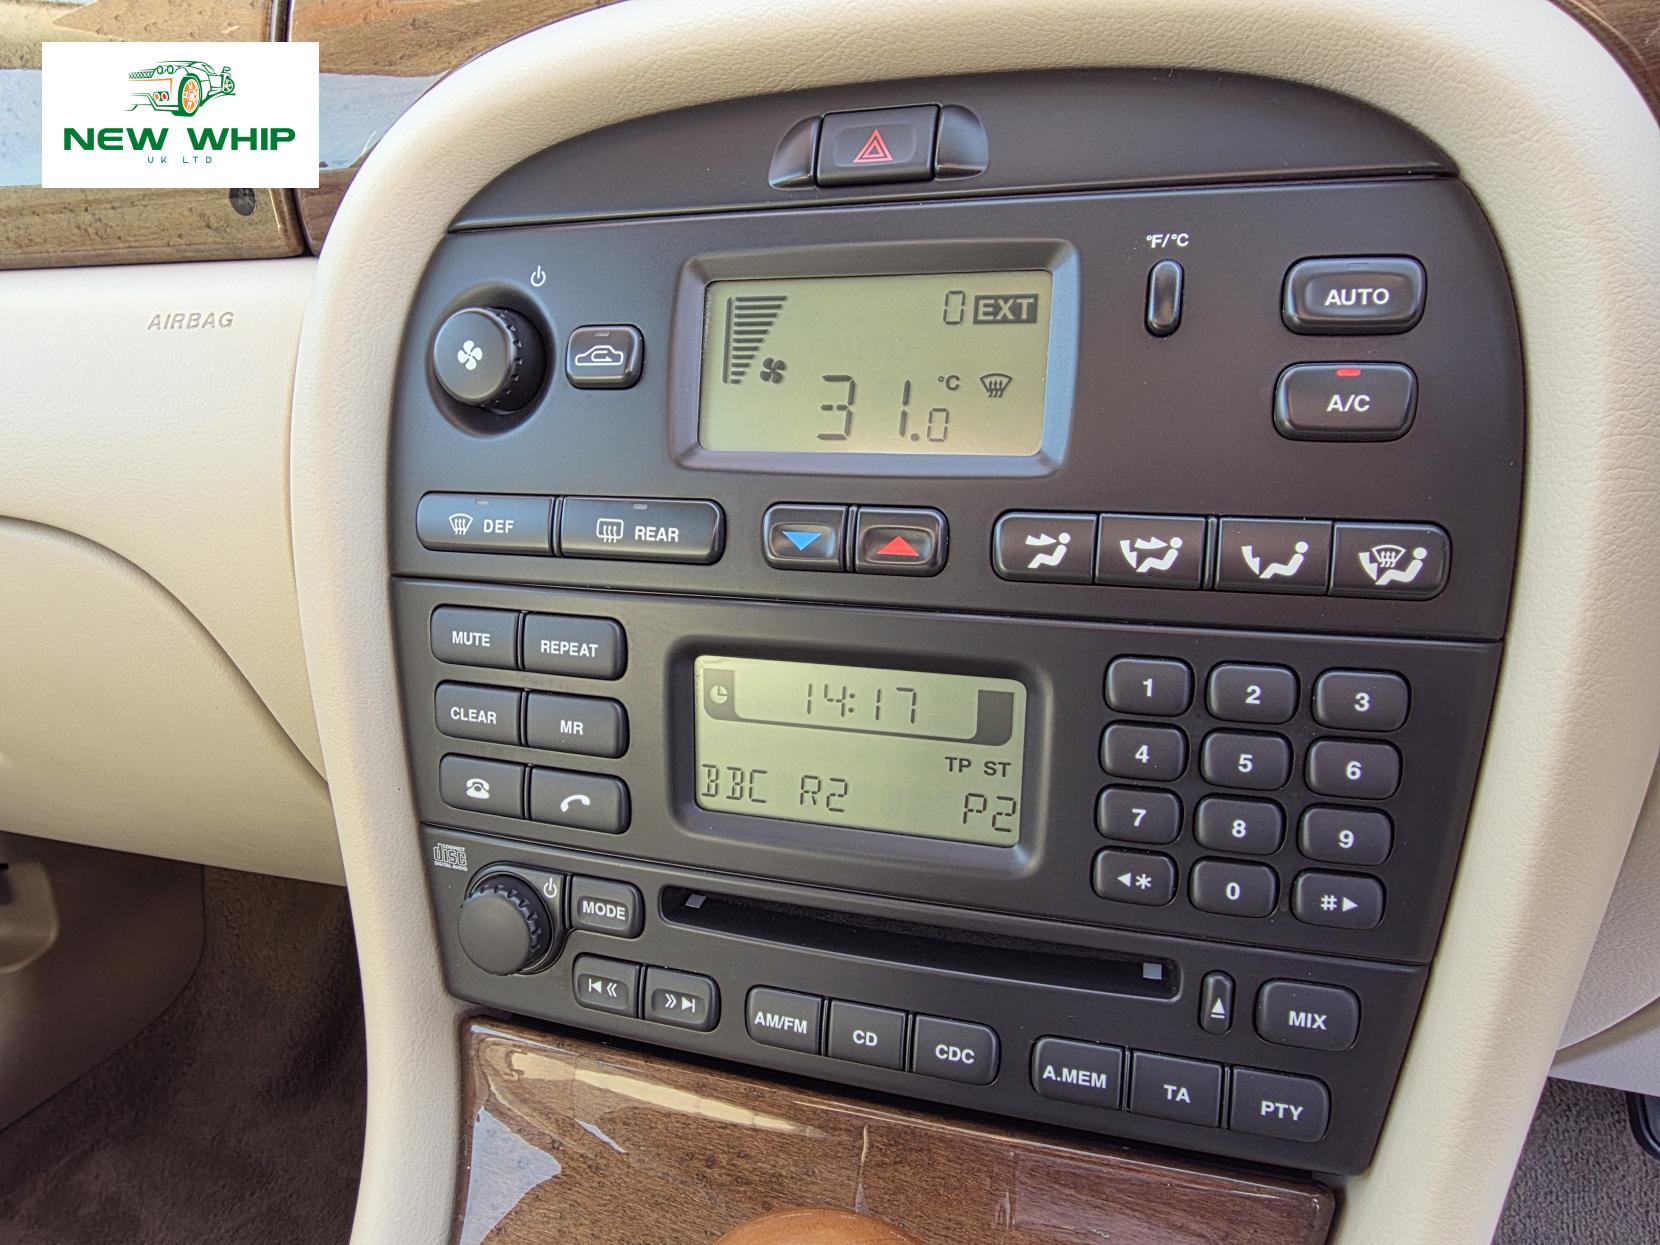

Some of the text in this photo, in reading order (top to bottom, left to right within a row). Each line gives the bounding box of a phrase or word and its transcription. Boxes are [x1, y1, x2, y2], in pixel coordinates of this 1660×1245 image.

[1324, 287, 1390, 306] AUTO
[977, 297, 1035, 320] EXT
[147, 311, 235, 330] AIRBAG
[1326, 394, 1371, 412] A/C
[483, 519, 514, 533] DEF
[634, 526, 679, 542] REAR
[452, 630, 490, 647] MUTE
[540, 639, 598, 658] REPEAT
[1142, 678, 1153, 697] 1
[1245, 685, 1261, 705] 2
[804, 682, 917, 725] 14:17
[1354, 692, 1370, 712] 3
[450, 706, 497, 725] CLEAR
[560, 719, 584, 736] MR
[1135, 744, 1150, 764] 4
[1238, 754, 1253, 773] 5
[945, 756, 1011, 778] TP ST
[1346, 761, 1362, 780] 6
[701, 763, 848, 812] BBC R2
[962, 792, 1017, 833] P2
[1131, 808, 1147, 827] 7
[1231, 820, 1247, 838] 8
[1338, 830, 1355, 849] 9
[1225, 882, 1241, 900] 0
[582, 900, 626, 921] MODE
[754, 1010, 808, 1035] AM/FM
[1288, 1010, 1328, 1031] MIX
[852, 1029, 878, 1047] CD
[935, 1044, 976, 1065] CDC
[1042, 1064, 1108, 1090] A.MEM
[1163, 1084, 1192, 1104] TA
[1260, 1100, 1304, 1122] PTY
